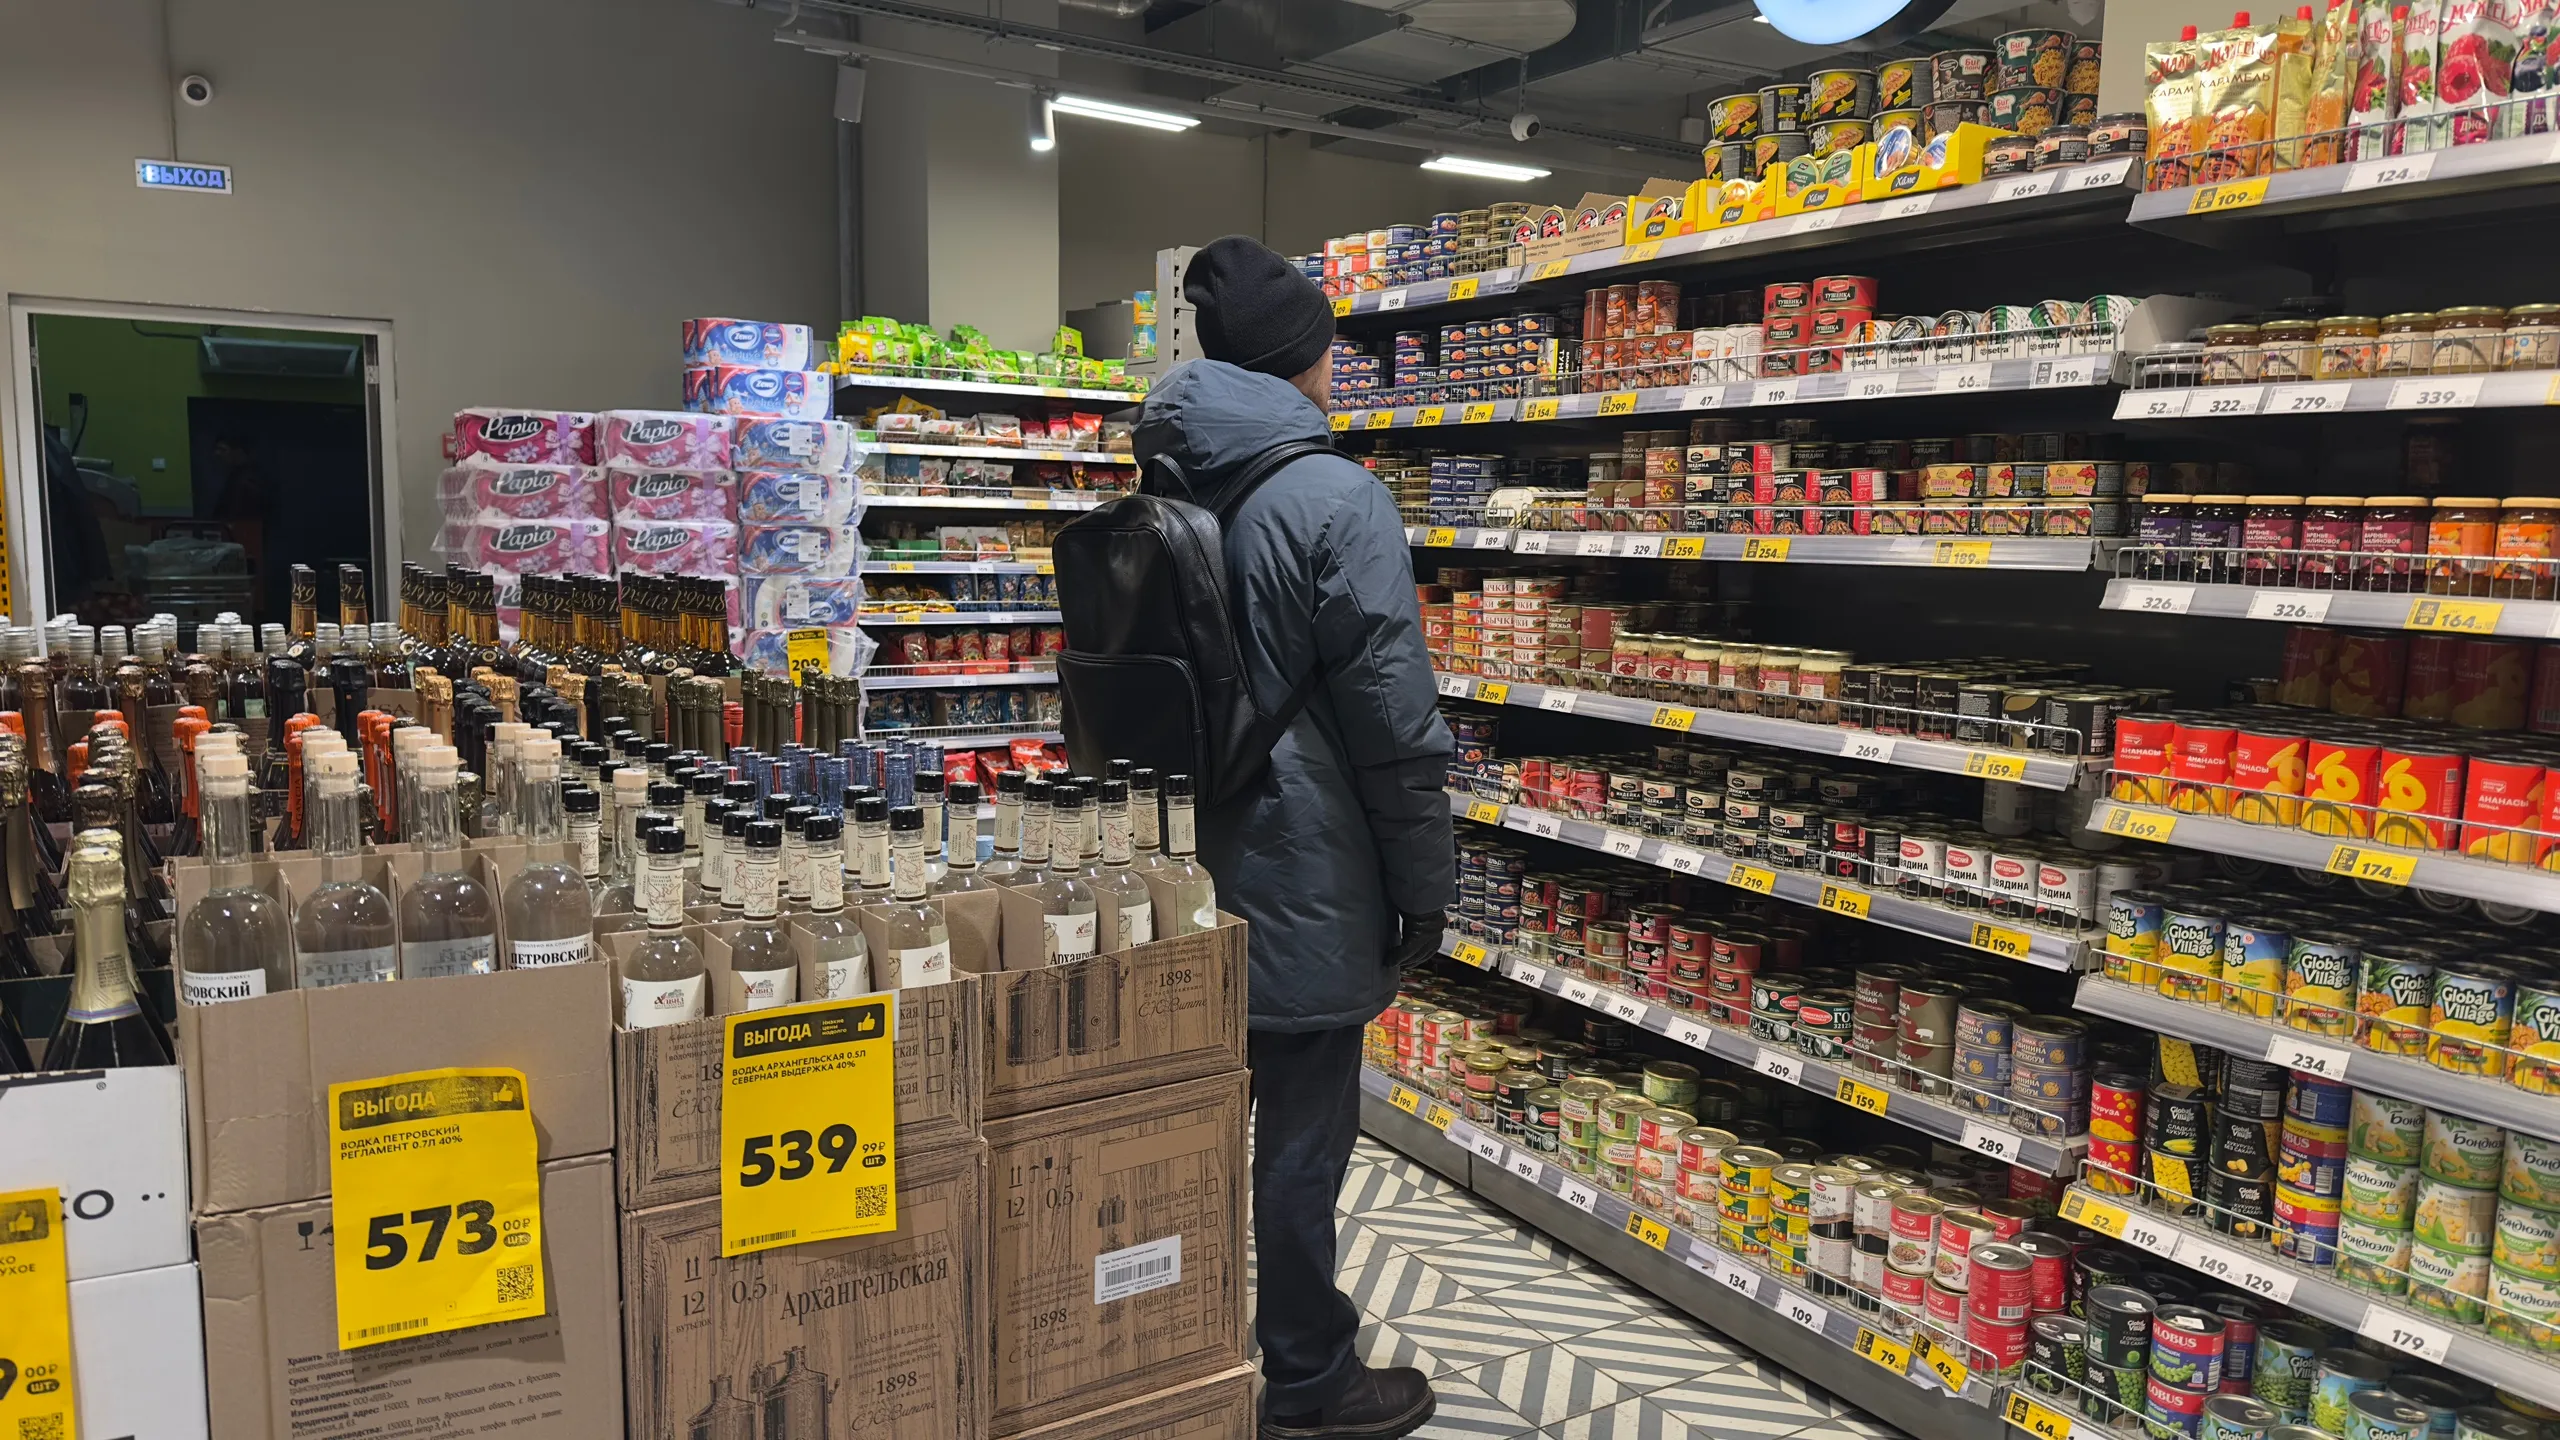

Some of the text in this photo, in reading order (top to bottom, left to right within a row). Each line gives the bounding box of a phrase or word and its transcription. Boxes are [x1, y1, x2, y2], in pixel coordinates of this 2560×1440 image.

[2010, 40, 2026, 50] Биг
[1965, 58, 1981, 68] Биг
[2200, 73, 2271, 88] КАРАМЕЛЬ
[2150, 86, 2194, 99] КАРАМ
[146, 165, 224, 188] ВЫХОД
[2084, 173, 2110, 185] 169
[2377, 168, 2409, 183] 124
[2012, 184, 2037, 197] 169
[2218, 192, 2248, 206] 109
[1958, 376, 1974, 388] 66
[2055, 371, 2079, 384] 139
[1768, 391, 1785, 401] 119
[1863, 384, 1884, 396] 139
[2417, 390, 2456, 404] 339
[1610, 403, 1626, 412] 299
[1700, 396, 1712, 406] 47
[2147, 402, 2167, 414] 52
[2211, 399, 2240, 412] 322
[2291, 396, 2326, 411] 279
[487, 415, 541, 440] Papia
[626, 420, 680, 446] Papia
[497, 470, 552, 497] Papia
[633, 474, 687, 500] Papia
[496, 525, 553, 552] Papia
[632, 526, 688, 552] Papia
[1485, 537, 1497, 546] 189
[1525, 542, 1539, 552] 244
[1633, 545, 1650, 555] 329
[1676, 546, 1693, 556] 259
[1758, 548, 1777, 559] 254
[1954, 553, 1976, 564] 189
[2142, 597, 2172, 611] 326
[2273, 604, 2306, 618] 326
[2441, 614, 2475, 629] 164
[1551, 700, 1566, 709] 234
[1666, 717, 1682, 728] 262
[1856, 745, 1879, 757] 269
[2121, 747, 2162, 757] АНАНАСЫ
[2187, 755, 2226, 766] АНАНАСЫ
[1987, 764, 2010, 777] 159
[2478, 795, 2529, 807] АНАНАСЫ
[1536, 823, 1551, 834] 306
[2130, 822, 2157, 837] 169
[1615, 842, 1630, 853] 179
[1673, 858, 1690, 869] 189
[2363, 862, 2392, 880] 174
[1744, 876, 1762, 888] 219
[1840, 901, 1857, 913] 122
[2169, 925, 2211, 943] Global
[1992, 938, 2016, 954] 199
[2171, 938, 2215, 958] Village
[510, 944, 590, 966] ПЕТРОВСКИЙ
[2301, 953, 2347, 972] Global
[1158, 969, 1192, 988] 1898
[1520, 972, 1535, 982] 249
[2303, 965, 2351, 989] Village
[1571, 990, 1585, 1000] 199
[2442, 986, 2490, 1005] Global
[1618, 1005, 1634, 1017] 199
[2444, 1002, 2497, 1025] Village
[743, 1023, 812, 1047] ВЫГОДА
[1684, 1031, 1697, 1043] 99
[732, 1050, 866, 1077] ВОДКА АРХАНГЕЛЬСКАЯ 0.5Л
[1768, 1062, 1790, 1077] 209
[2291, 1053, 2326, 1072] 234
[732, 1060, 856, 1086] СЕВЕРНАЯ ВЫДЕРЖКА 40%
[353, 1092, 437, 1118] ВЫГОДА
[1855, 1095, 1875, 1109] 159
[340, 1124, 460, 1151] ВОДКА ПЕТРОВСКИЙ
[341, 1135, 463, 1160] РЕГЛАМЕНТ 0.7Л 40%
[1480, 1144, 1493, 1157] 149
[1977, 1136, 2004, 1155] 289
[740, 1123, 858, 1188] 539
[1518, 1163, 1532, 1176] 189
[1570, 1191, 1586, 1204] 219
[1008, 1196, 1025, 1219] 12
[2091, 1215, 2108, 1230] 52
[366, 1200, 498, 1270] 573
[1645, 1230, 1657, 1243] 99
[2132, 1229, 2157, 1246] 119
[2341, 1226, 2395, 1254] Бондюэль
[2200, 1255, 2228, 1274] 149
[1728, 1273, 1747, 1291] 134
[2244, 1273, 2273, 1293] 129
[780, 1257, 949, 1325] Архангельская
[683, 1290, 706, 1316] 12
[1031, 1308, 1067, 1331] 1898
[1792, 1306, 1812, 1324] 109
[2153, 1322, 2197, 1349] GLOBUS
[2391, 1329, 2424, 1350] 179
[1881, 1350, 1896, 1365] 79
[1936, 1361, 1952, 1379] 42
[877, 1371, 917, 1396] 1898
[2035, 1420, 2054, 1437] 64
